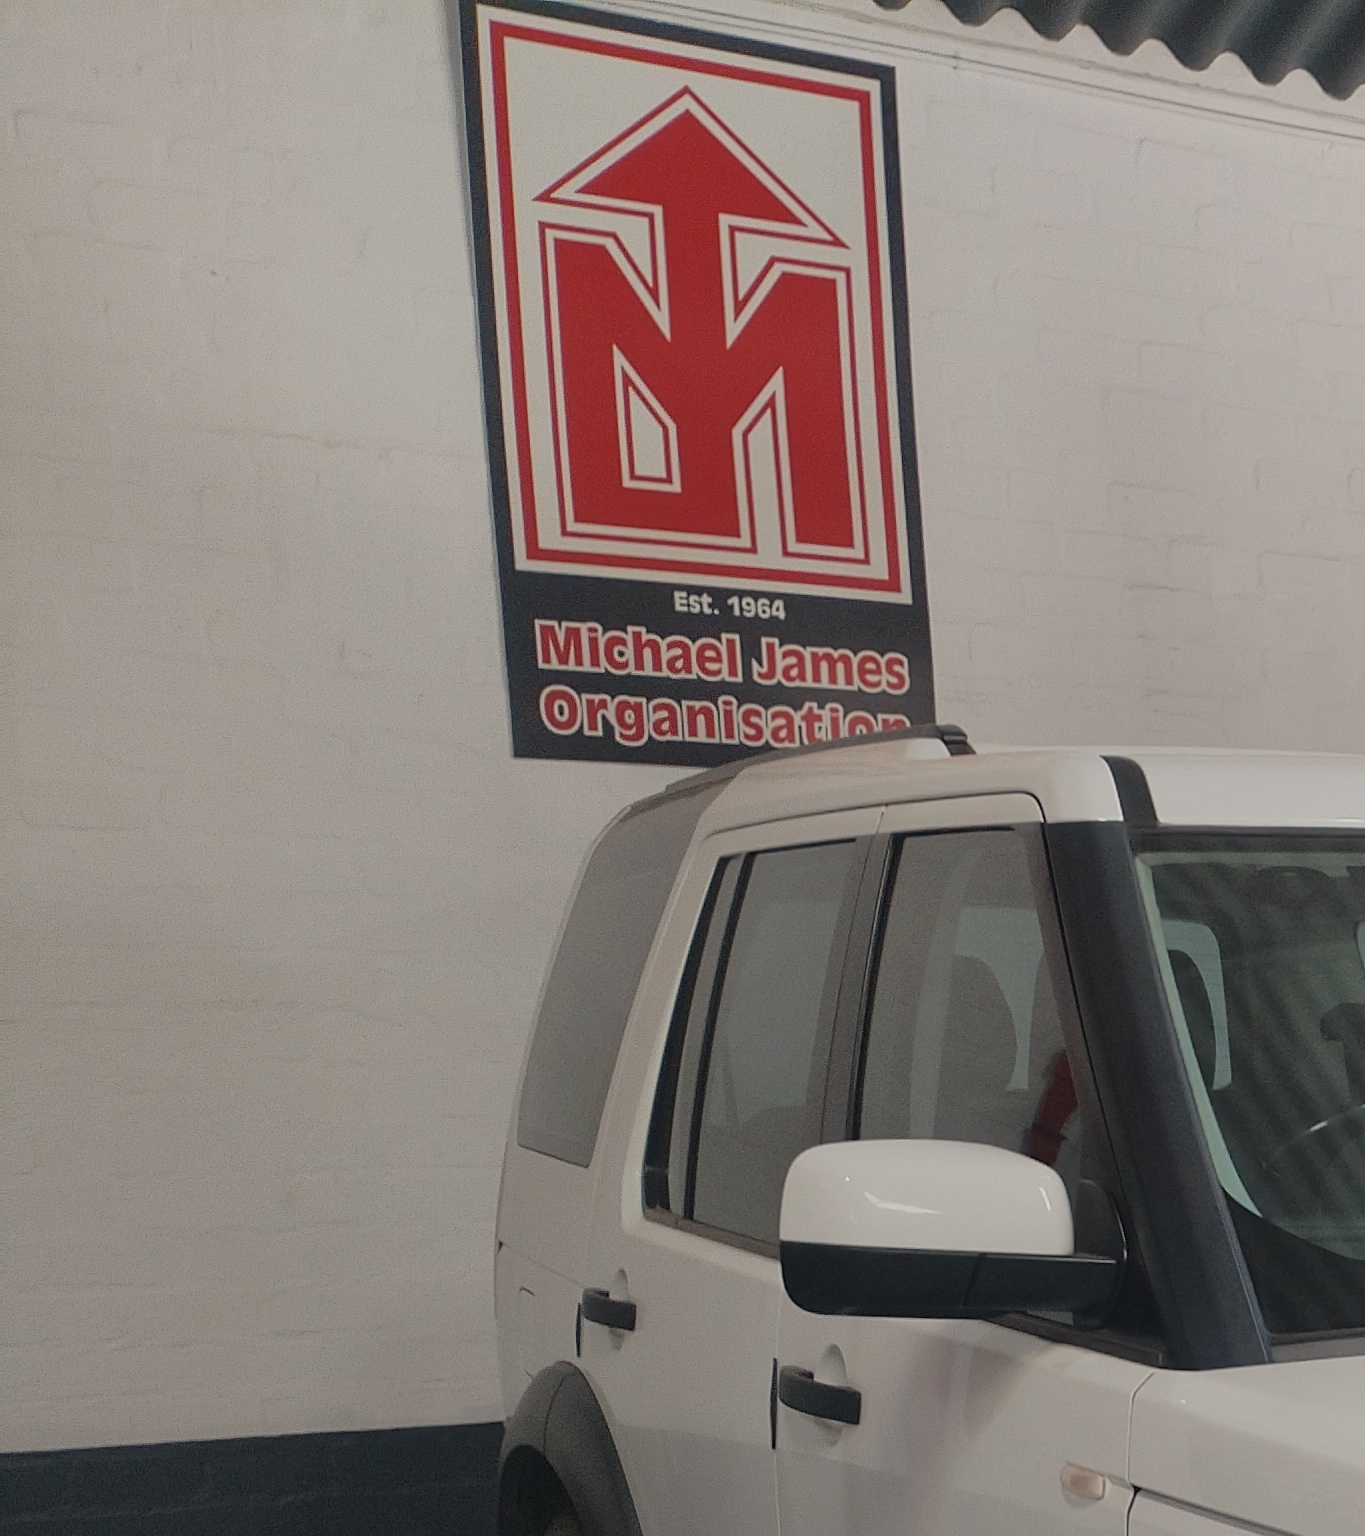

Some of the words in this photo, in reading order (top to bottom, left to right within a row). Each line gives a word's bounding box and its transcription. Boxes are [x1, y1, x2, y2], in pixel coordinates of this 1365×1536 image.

[673, 590, 720, 616] Est.
[727, 596, 787, 621] 1964
[534, 618, 743, 683] Michael
[752, 635, 911, 695] James
